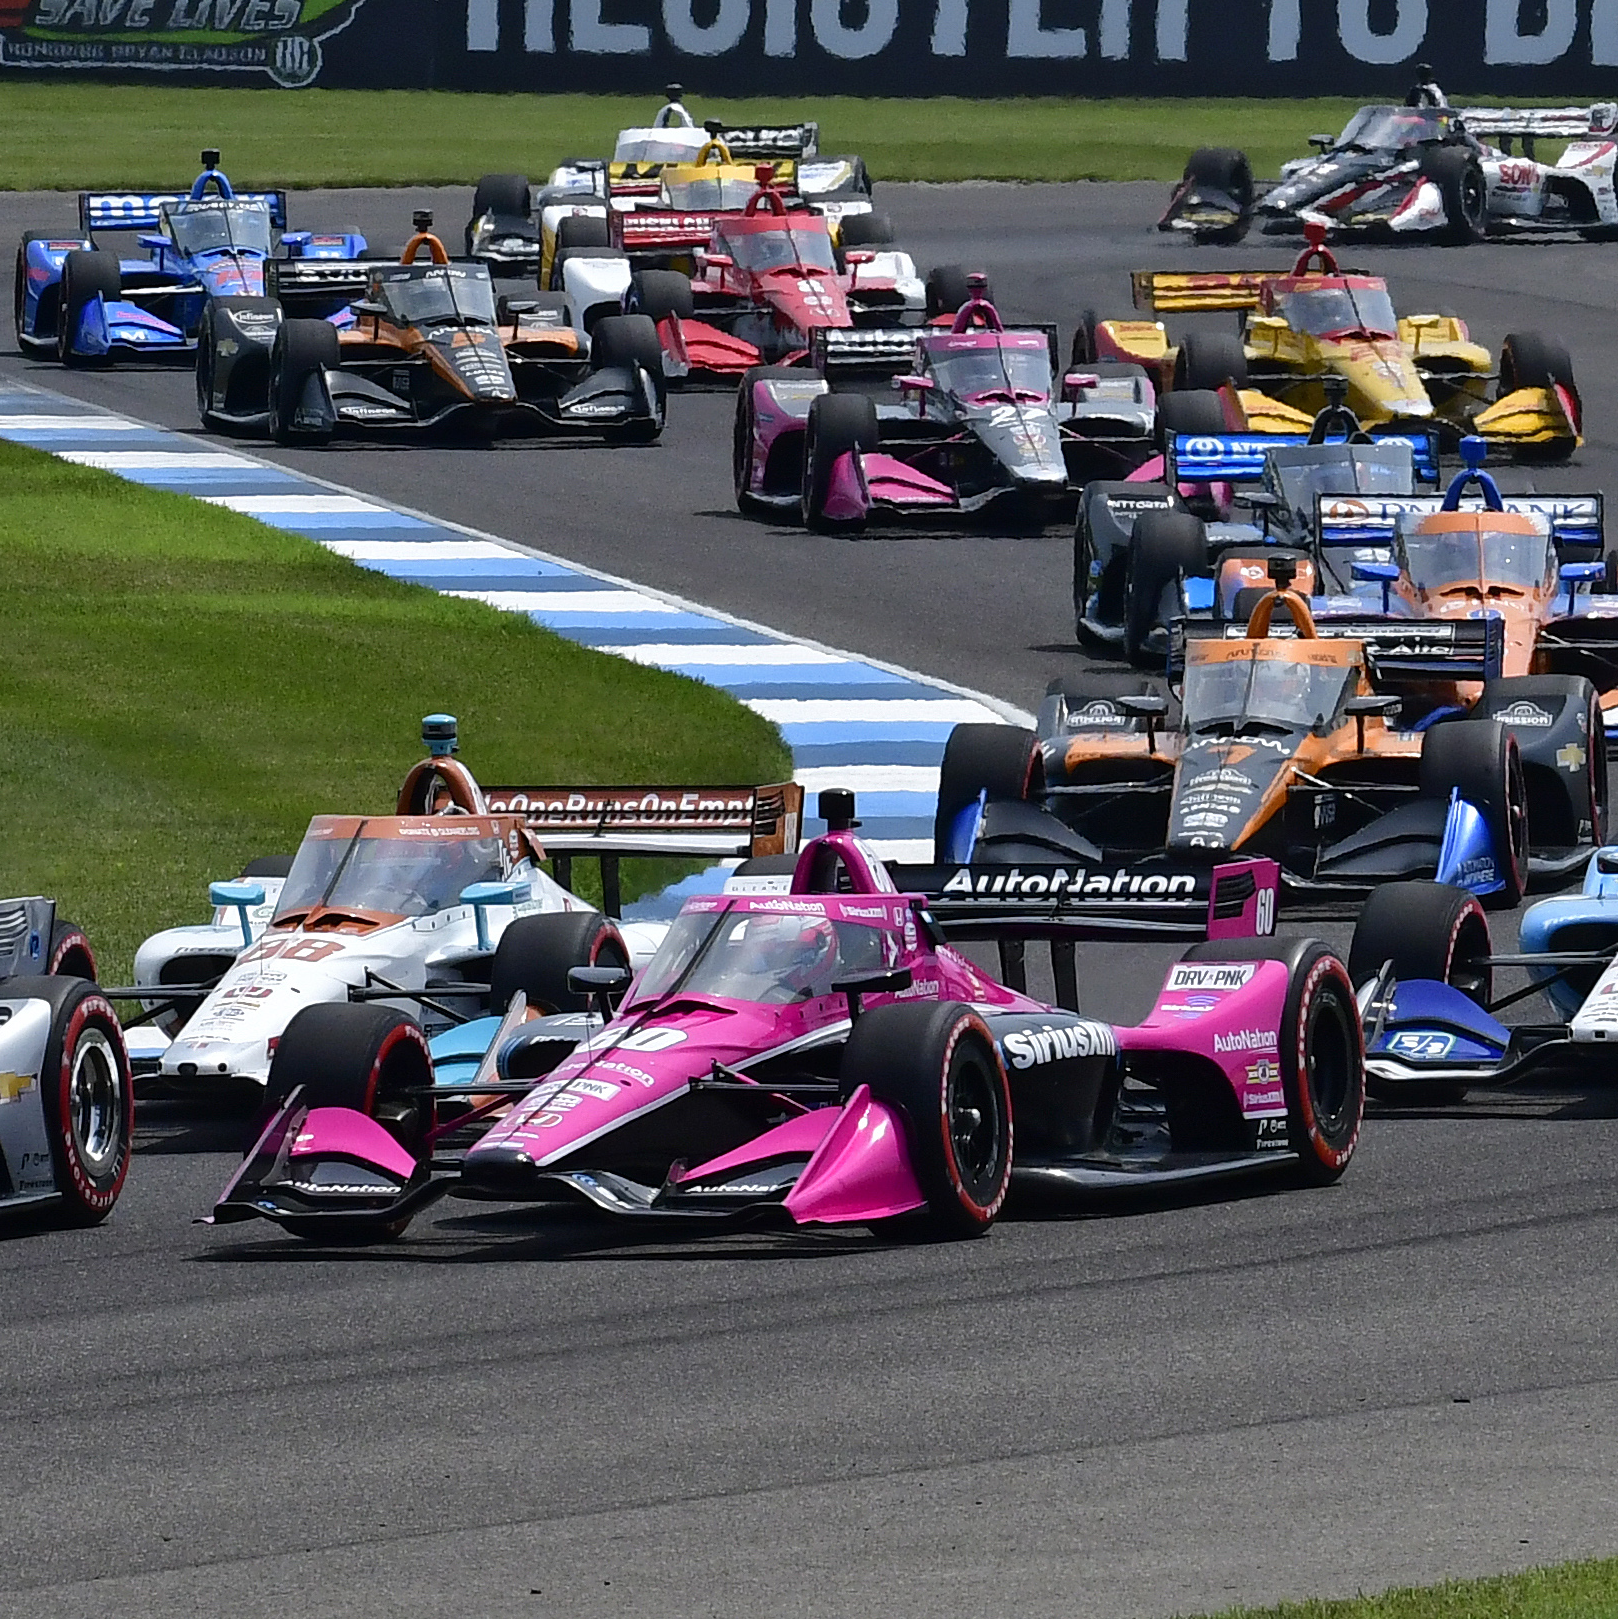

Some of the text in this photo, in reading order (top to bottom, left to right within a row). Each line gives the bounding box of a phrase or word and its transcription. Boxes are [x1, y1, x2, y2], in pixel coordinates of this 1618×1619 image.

[1496, 714, 1548, 724] mission
[942, 867, 1196, 902] AutoNation
[749, 900, 825, 912] AutoNation
[1256, 888, 1274, 937] 60
[1174, 970, 1247, 986] DRV PNK
[1214, 1028, 1277, 1053] AutoNation
[575, 1080, 608, 1095] PNK
[278, 1179, 402, 1194] AutoNation
